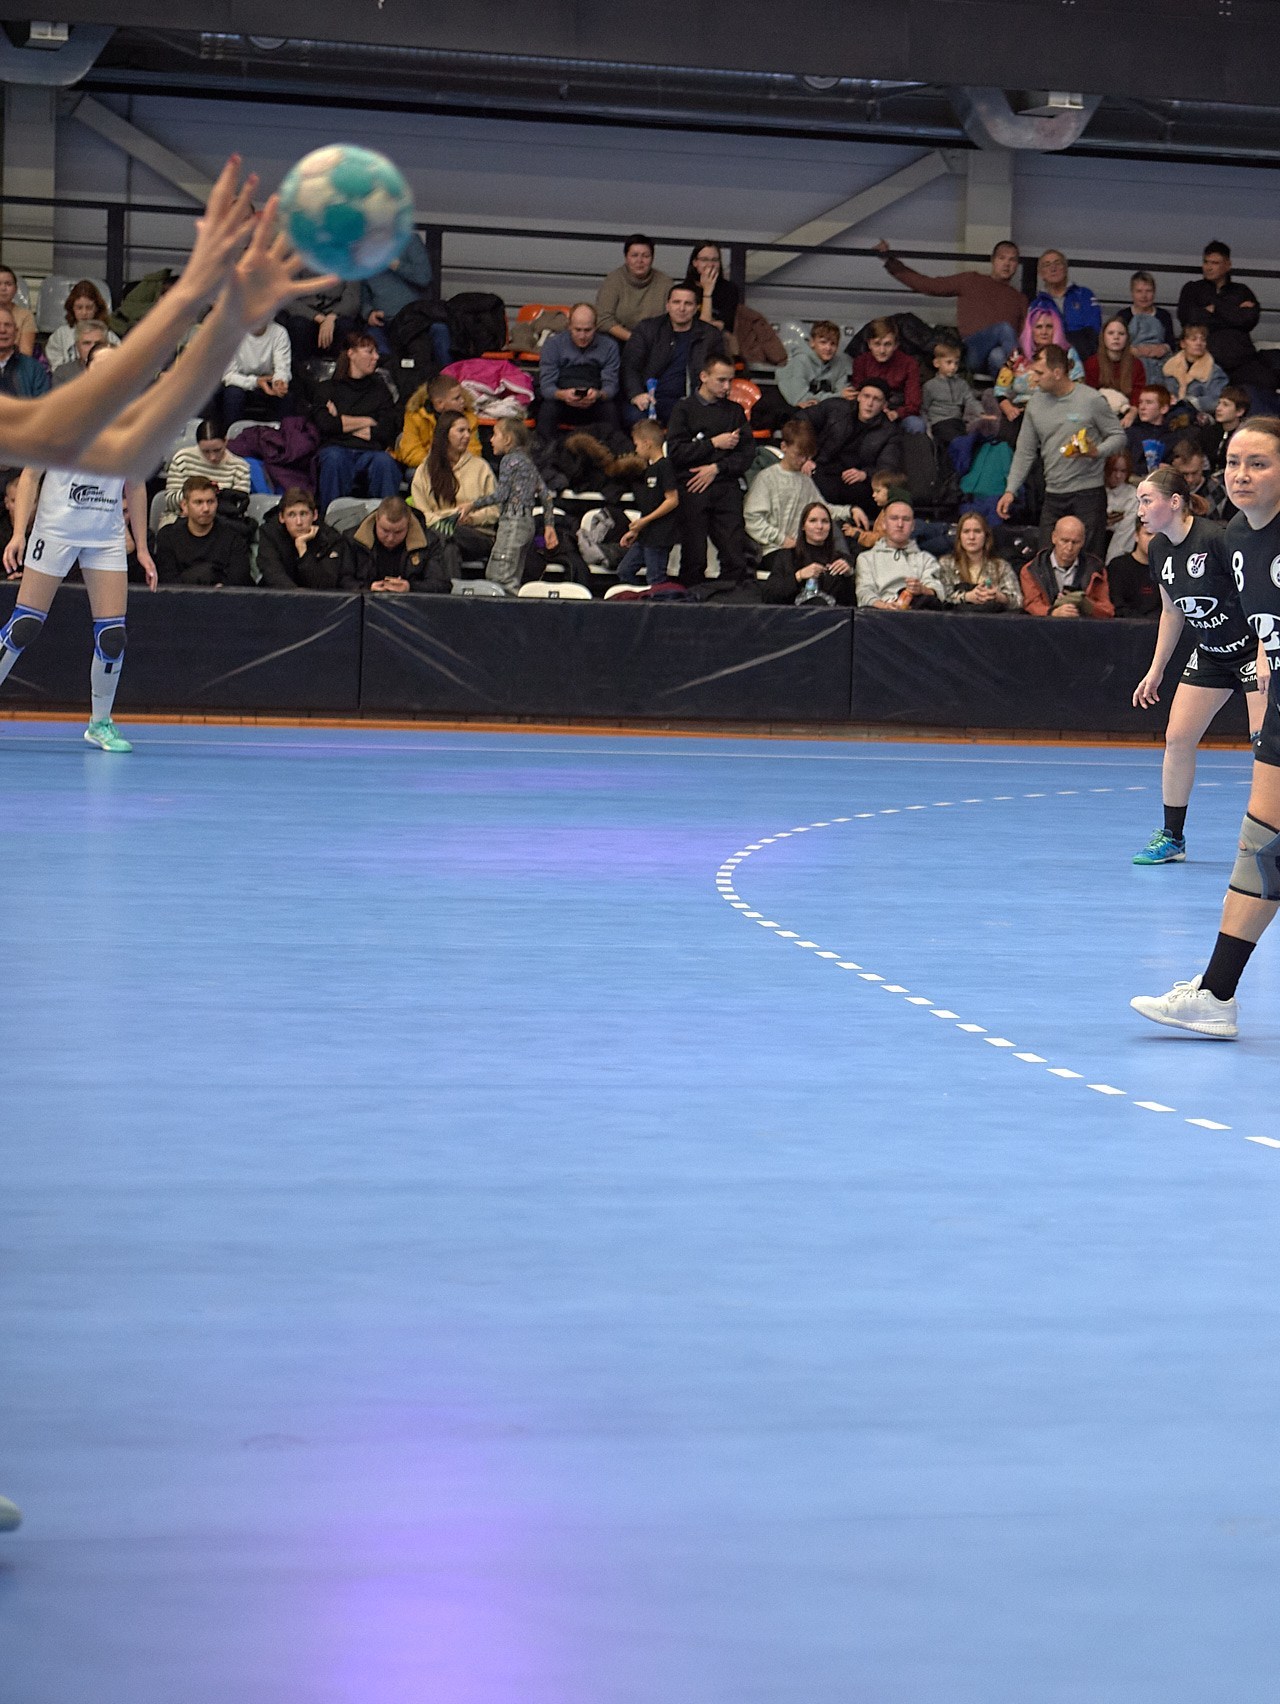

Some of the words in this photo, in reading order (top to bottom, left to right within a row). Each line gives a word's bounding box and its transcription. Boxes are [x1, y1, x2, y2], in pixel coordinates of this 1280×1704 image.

[32, 538, 46, 562] 8
[1161, 556, 1176, 585] 4
[1232, 550, 1245, 592] 8
